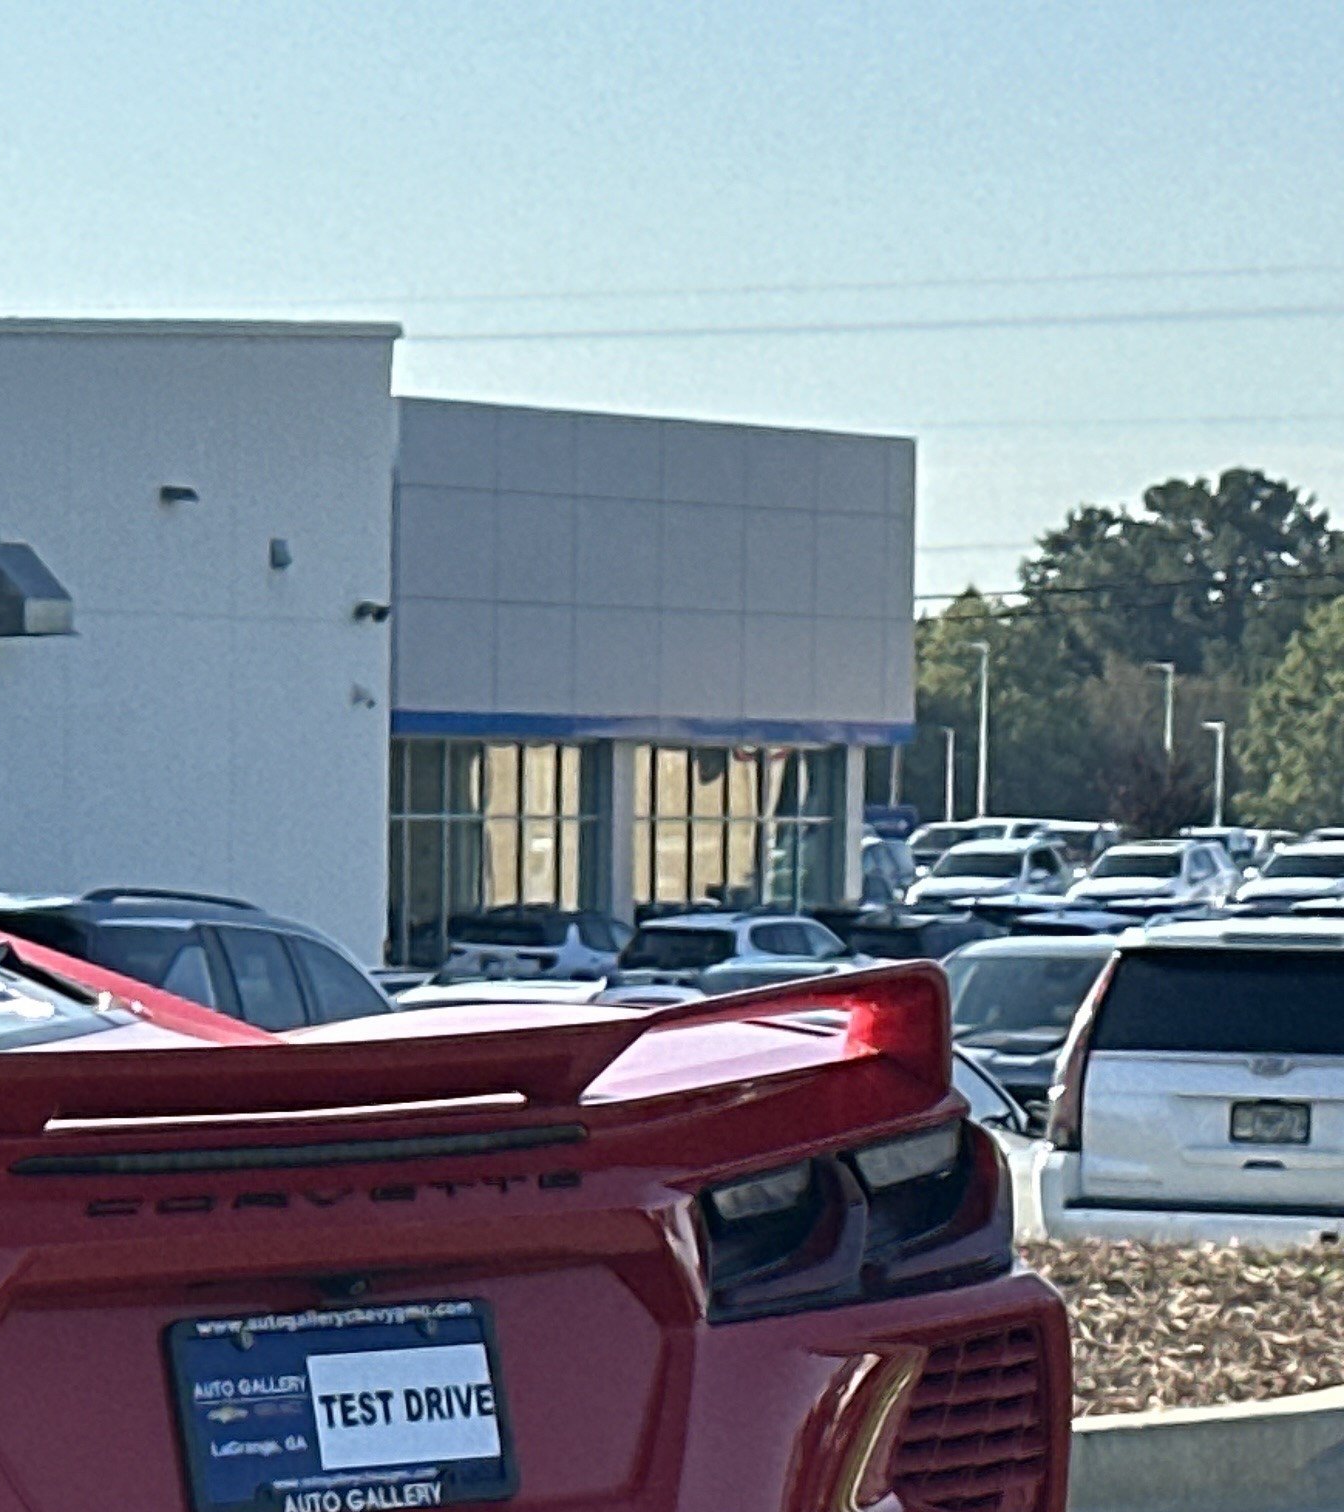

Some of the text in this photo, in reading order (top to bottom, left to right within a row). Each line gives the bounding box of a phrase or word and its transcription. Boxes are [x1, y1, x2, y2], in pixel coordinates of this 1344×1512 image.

[194, 1375, 307, 1400] AUTO GALLERY
[318, 1383, 495, 1429] TEST DRIVE
[346, 1480, 442, 1512] GALLERY
